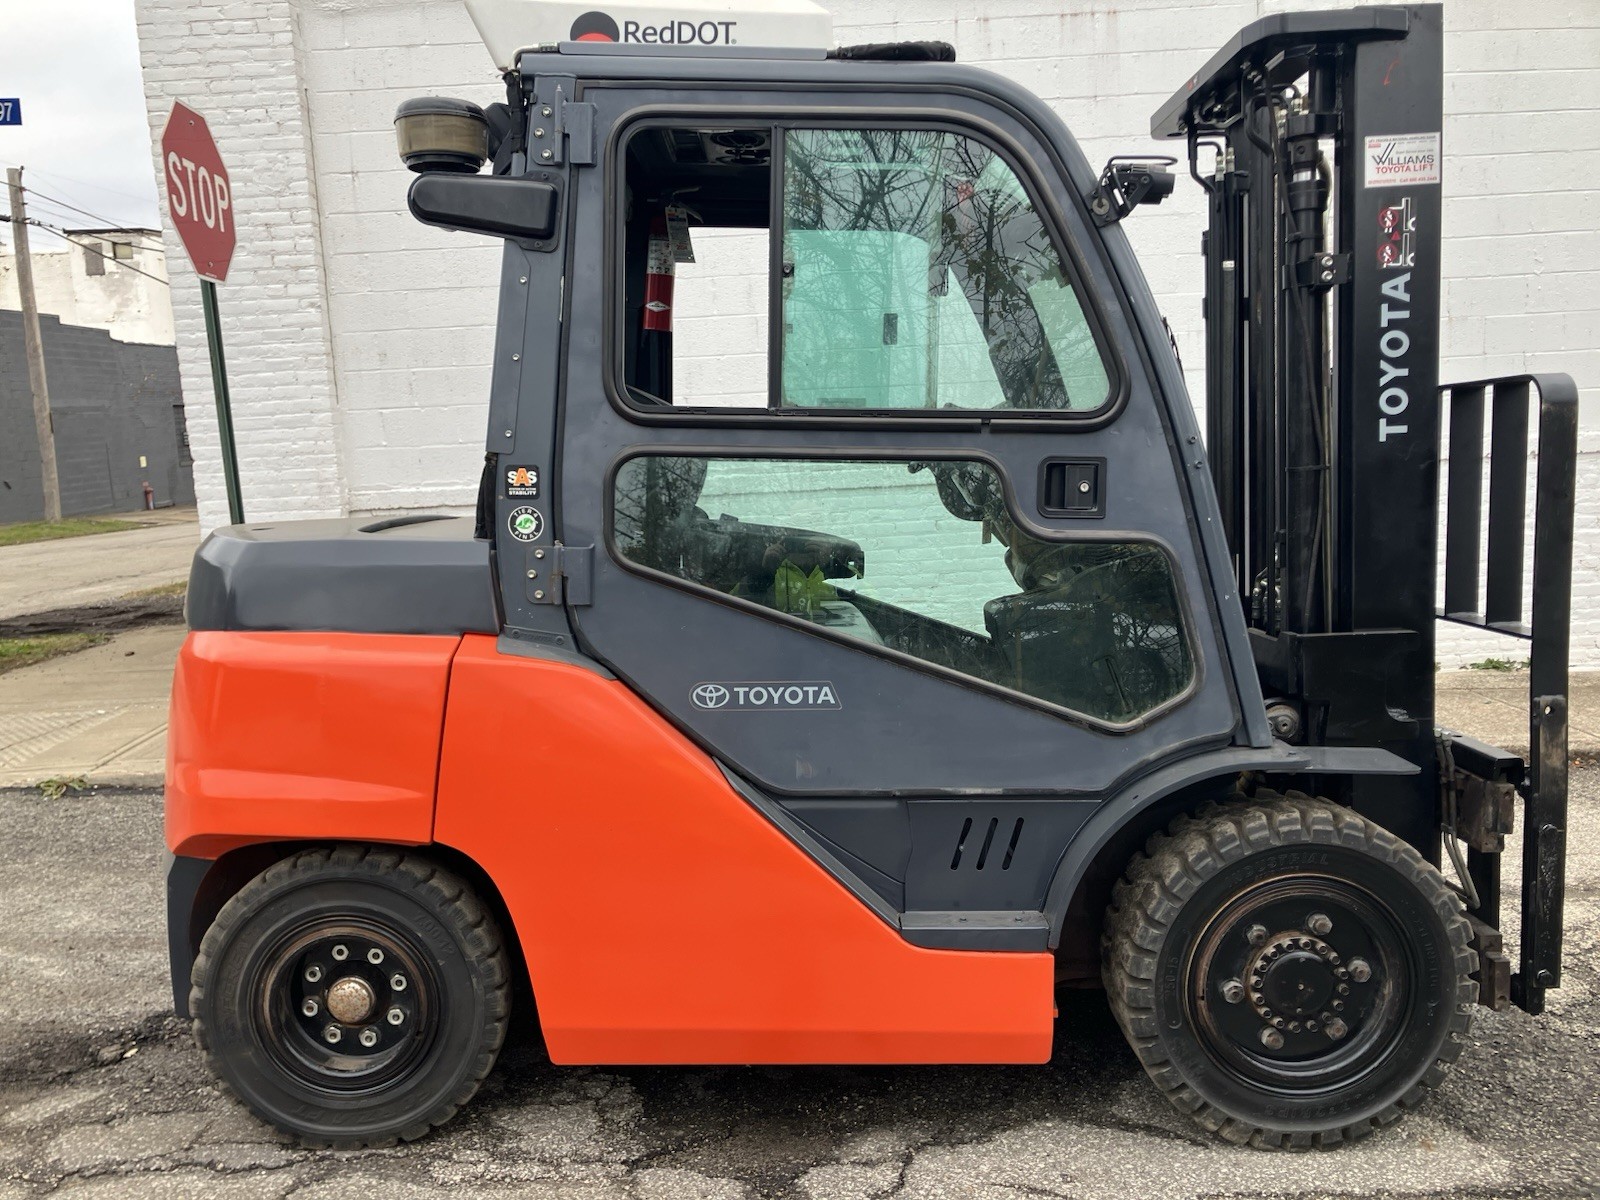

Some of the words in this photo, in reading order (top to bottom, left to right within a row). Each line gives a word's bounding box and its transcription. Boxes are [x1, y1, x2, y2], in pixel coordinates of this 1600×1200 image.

[1371, 142, 1435, 166] WILLIAMS
[1375, 165, 1411, 174] TOYOTA
[1413, 164, 1434, 172] LIFT
[168, 151, 229, 233] STOP
[1379, 272, 1411, 442] TOYOTA
[507, 467, 538, 486] SAS
[514, 508, 532, 517] TIER
[514, 530, 539, 540] FINAL
[733, 686, 836, 705] TOYOTA
